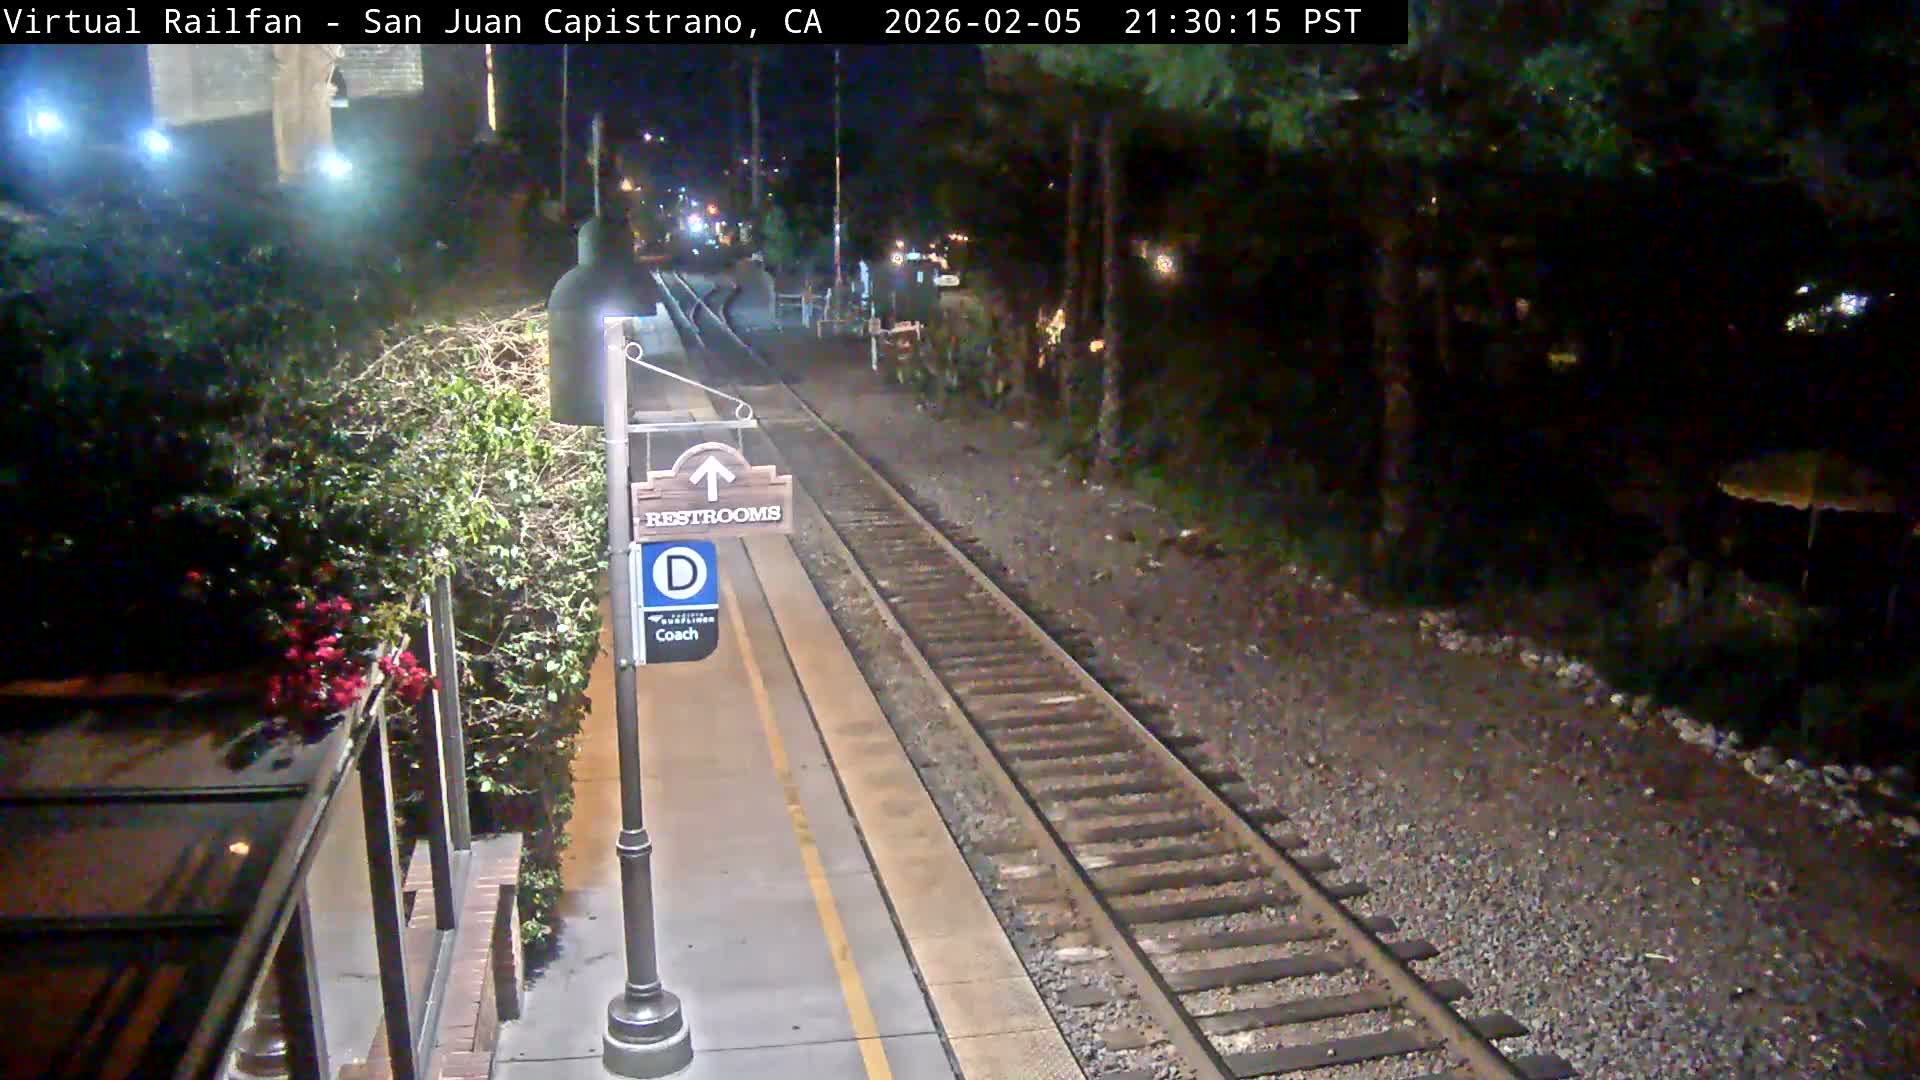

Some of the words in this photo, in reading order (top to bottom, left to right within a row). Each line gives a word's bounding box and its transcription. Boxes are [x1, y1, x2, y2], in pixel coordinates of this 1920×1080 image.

[645, 505, 782, 527] RESTROOMS
[667, 554, 698, 591] D
[655, 626, 699, 642] Coach
